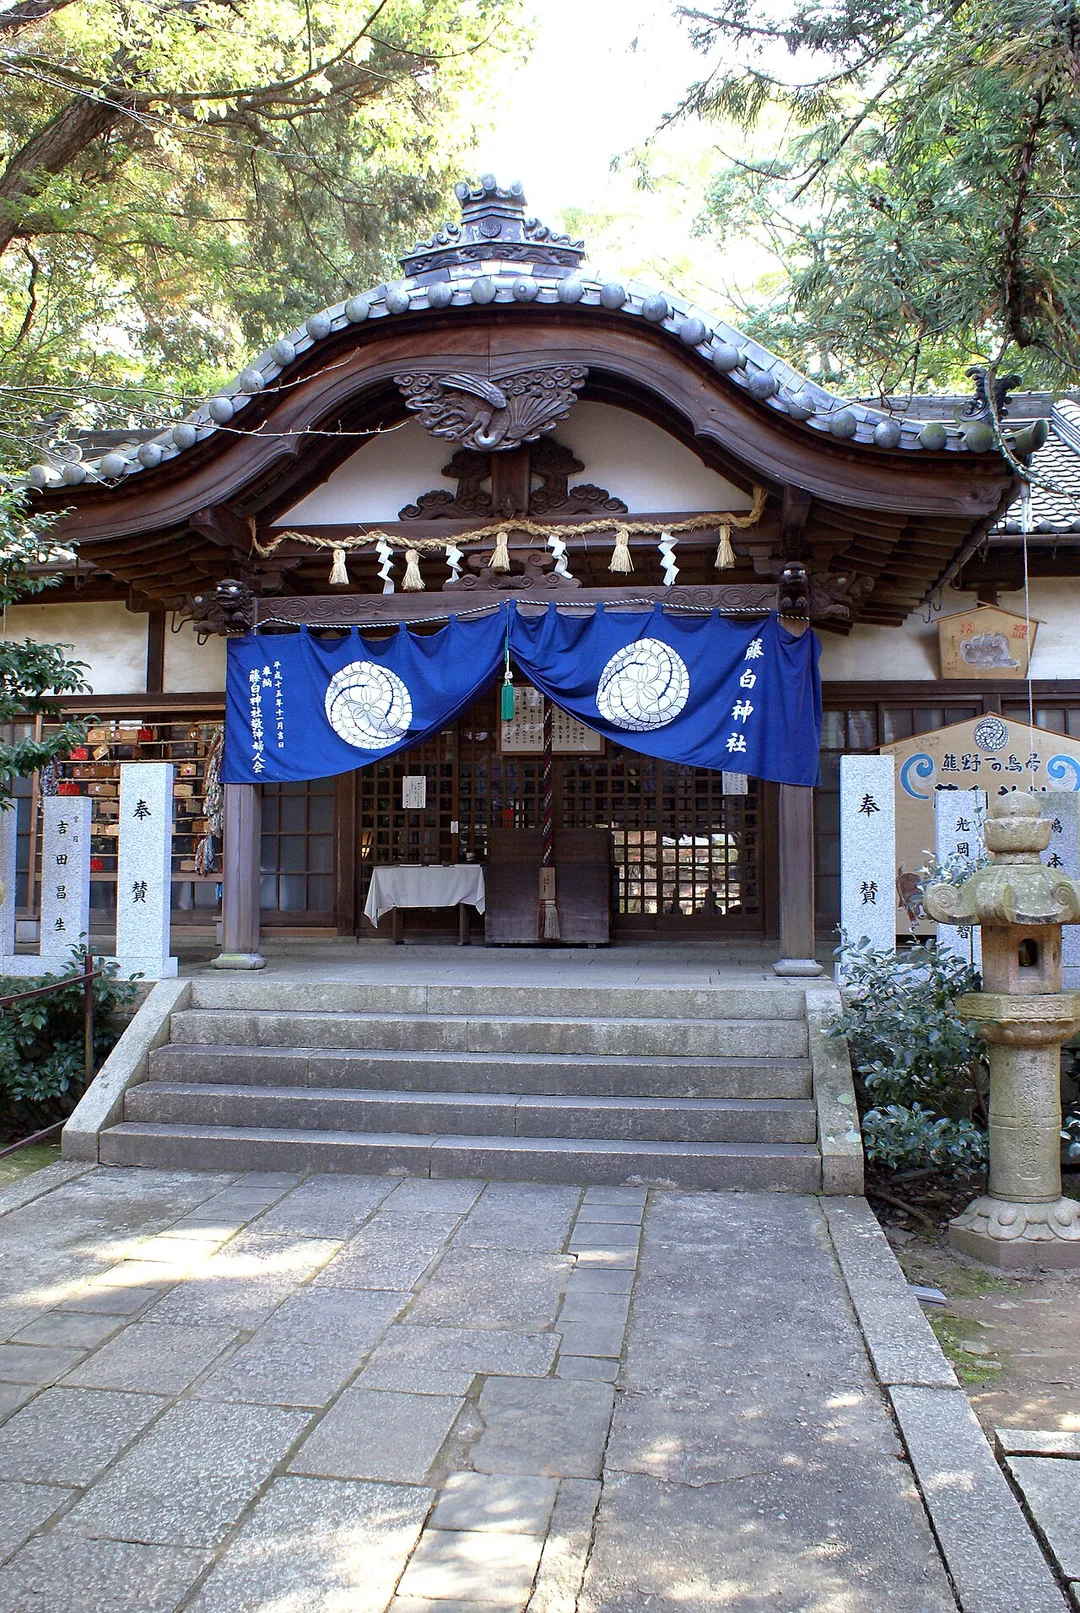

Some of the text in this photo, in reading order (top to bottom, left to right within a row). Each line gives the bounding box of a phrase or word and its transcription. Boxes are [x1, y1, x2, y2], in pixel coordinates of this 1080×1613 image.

[249, 668, 266, 773] 藤白神社敬神婦人会
[262, 665, 272, 688] 奉納
[273, 660, 284, 748] 平成十五年十一月吉日
[725, 638, 764, 753] 藤白神社
[54, 820, 69, 932] 吉田昌生
[133, 799, 151, 903] 奉賛
[857, 794, 880, 905] 奉賛
